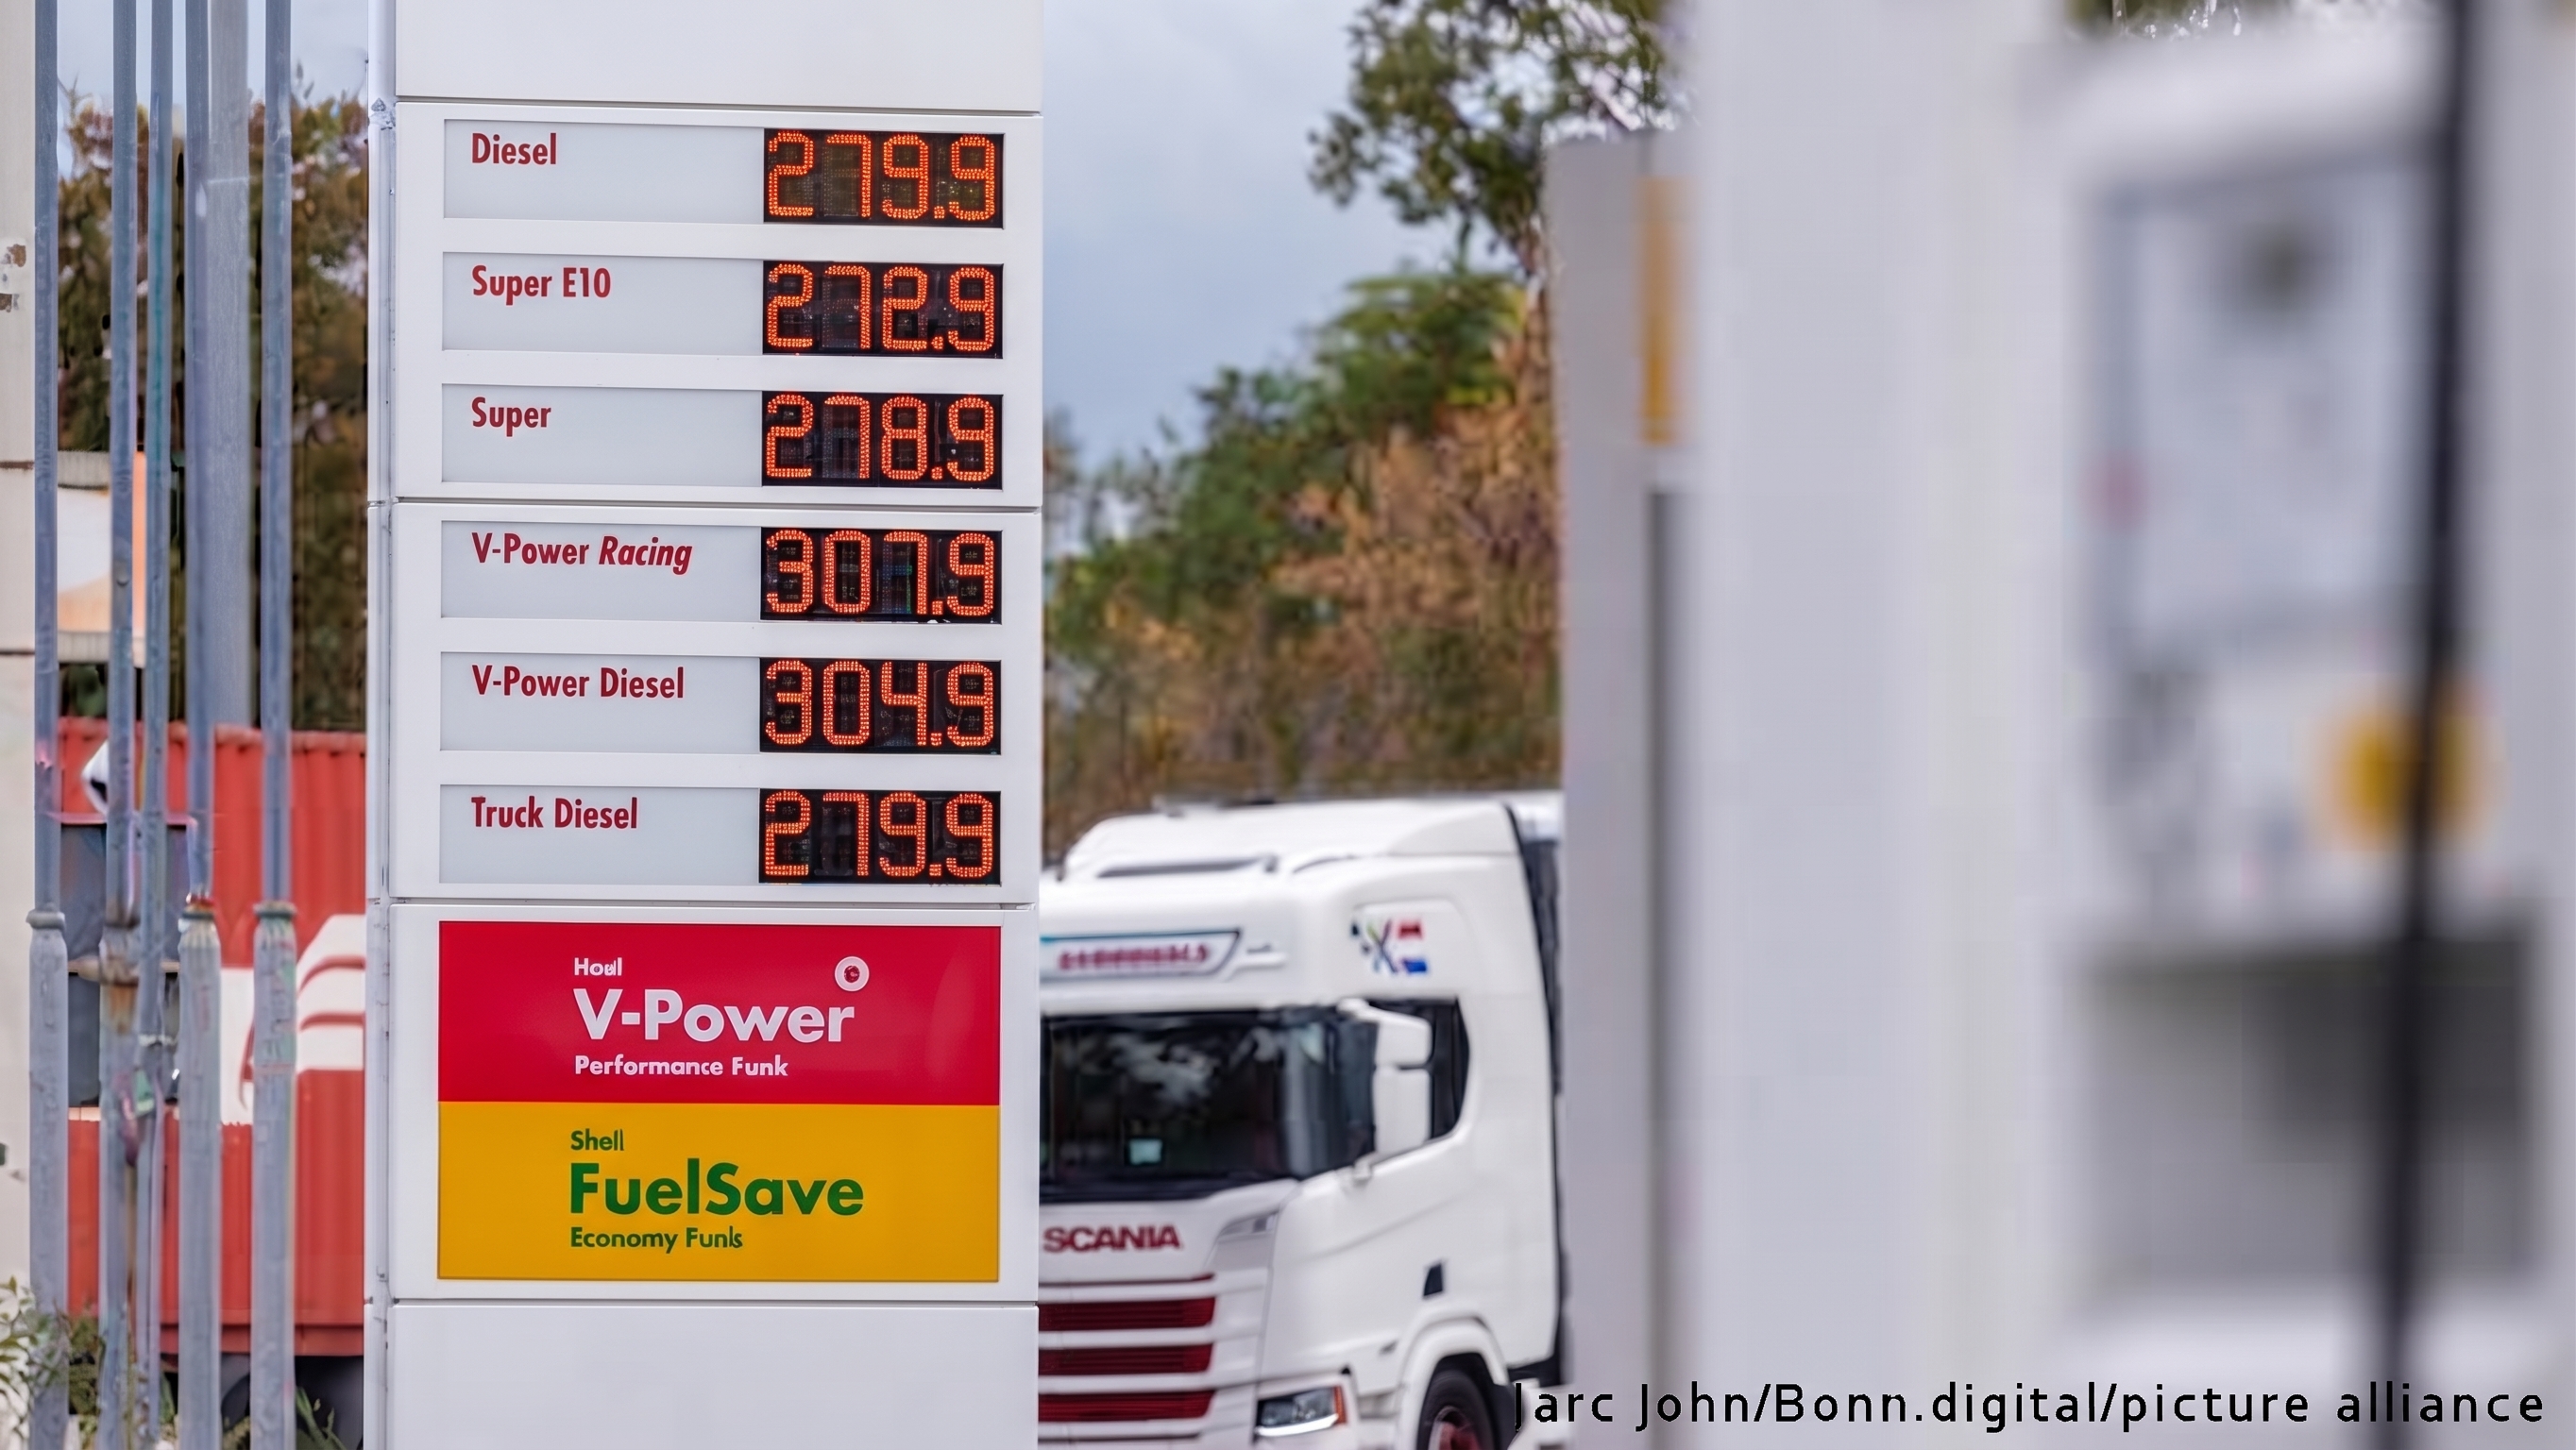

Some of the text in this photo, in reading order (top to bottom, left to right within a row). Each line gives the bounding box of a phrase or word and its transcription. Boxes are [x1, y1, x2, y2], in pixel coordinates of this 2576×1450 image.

[471, 132, 557, 166] Diesel
[768, 130, 995, 222] 279.9
[471, 264, 612, 306] Super E10
[766, 262, 995, 353] 272.9
[471, 396, 551, 437] Super
[766, 393, 995, 481] 278.9
[471, 531, 693, 576] V-Power Racing
[766, 529, 995, 616] 307.9
[471, 664, 685, 700] V-Power Diesel
[765, 659, 994, 748] 304.9
[471, 795, 638, 830] Truck Diesel
[765, 790, 994, 879] 279.9
[572, 987, 856, 1043] V-Power
[574, 1054, 789, 1077] Performance Funk
[570, 1127, 625, 1152] Shell
[569, 1157, 864, 1217] FuelSave
[570, 1226, 679, 1255] Economy
[1042, 1223, 1183, 1253] SCANIA
